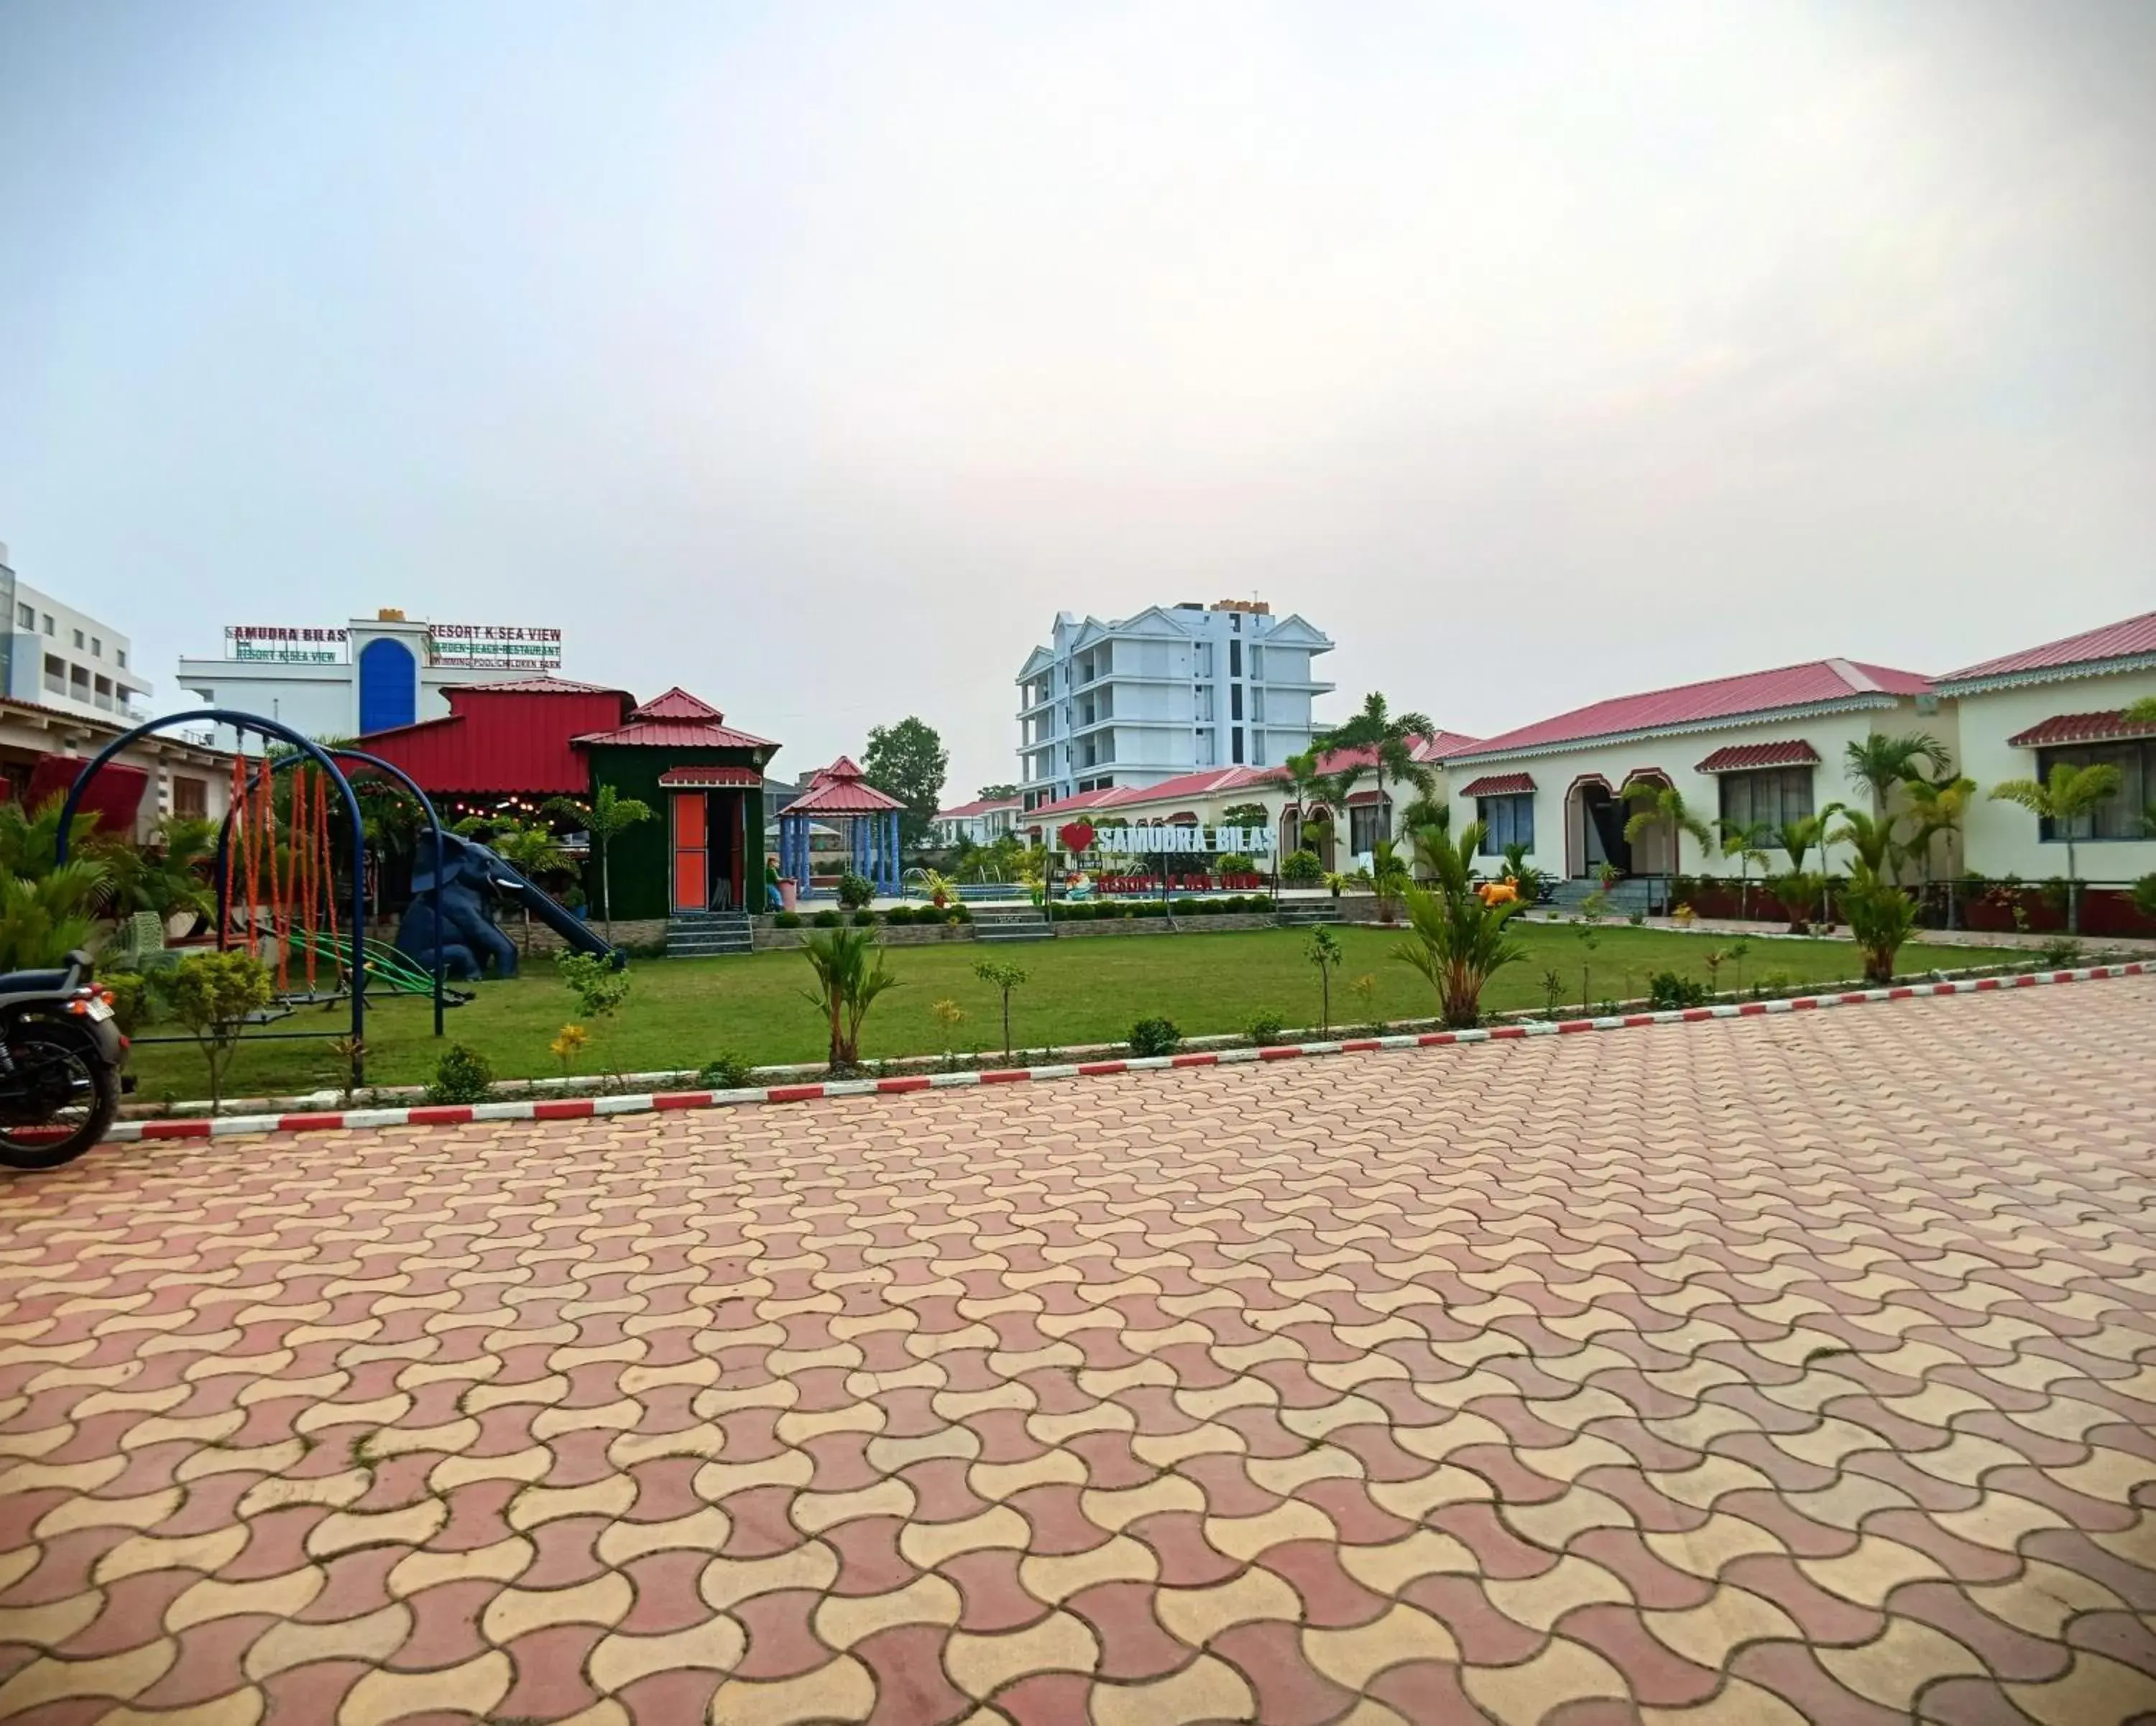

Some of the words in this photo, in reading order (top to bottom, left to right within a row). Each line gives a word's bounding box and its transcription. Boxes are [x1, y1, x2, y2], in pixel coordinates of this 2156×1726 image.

[303, 629, 347, 642] BILAS
[430, 624, 481, 638] RESORT
[485, 627, 494, 639] K
[499, 627, 524, 640] SEA
[528, 628, 561, 641] VIEW
[1097, 826, 1207, 852] SAMUDRA
[1215, 826, 1277, 852] BILAS
